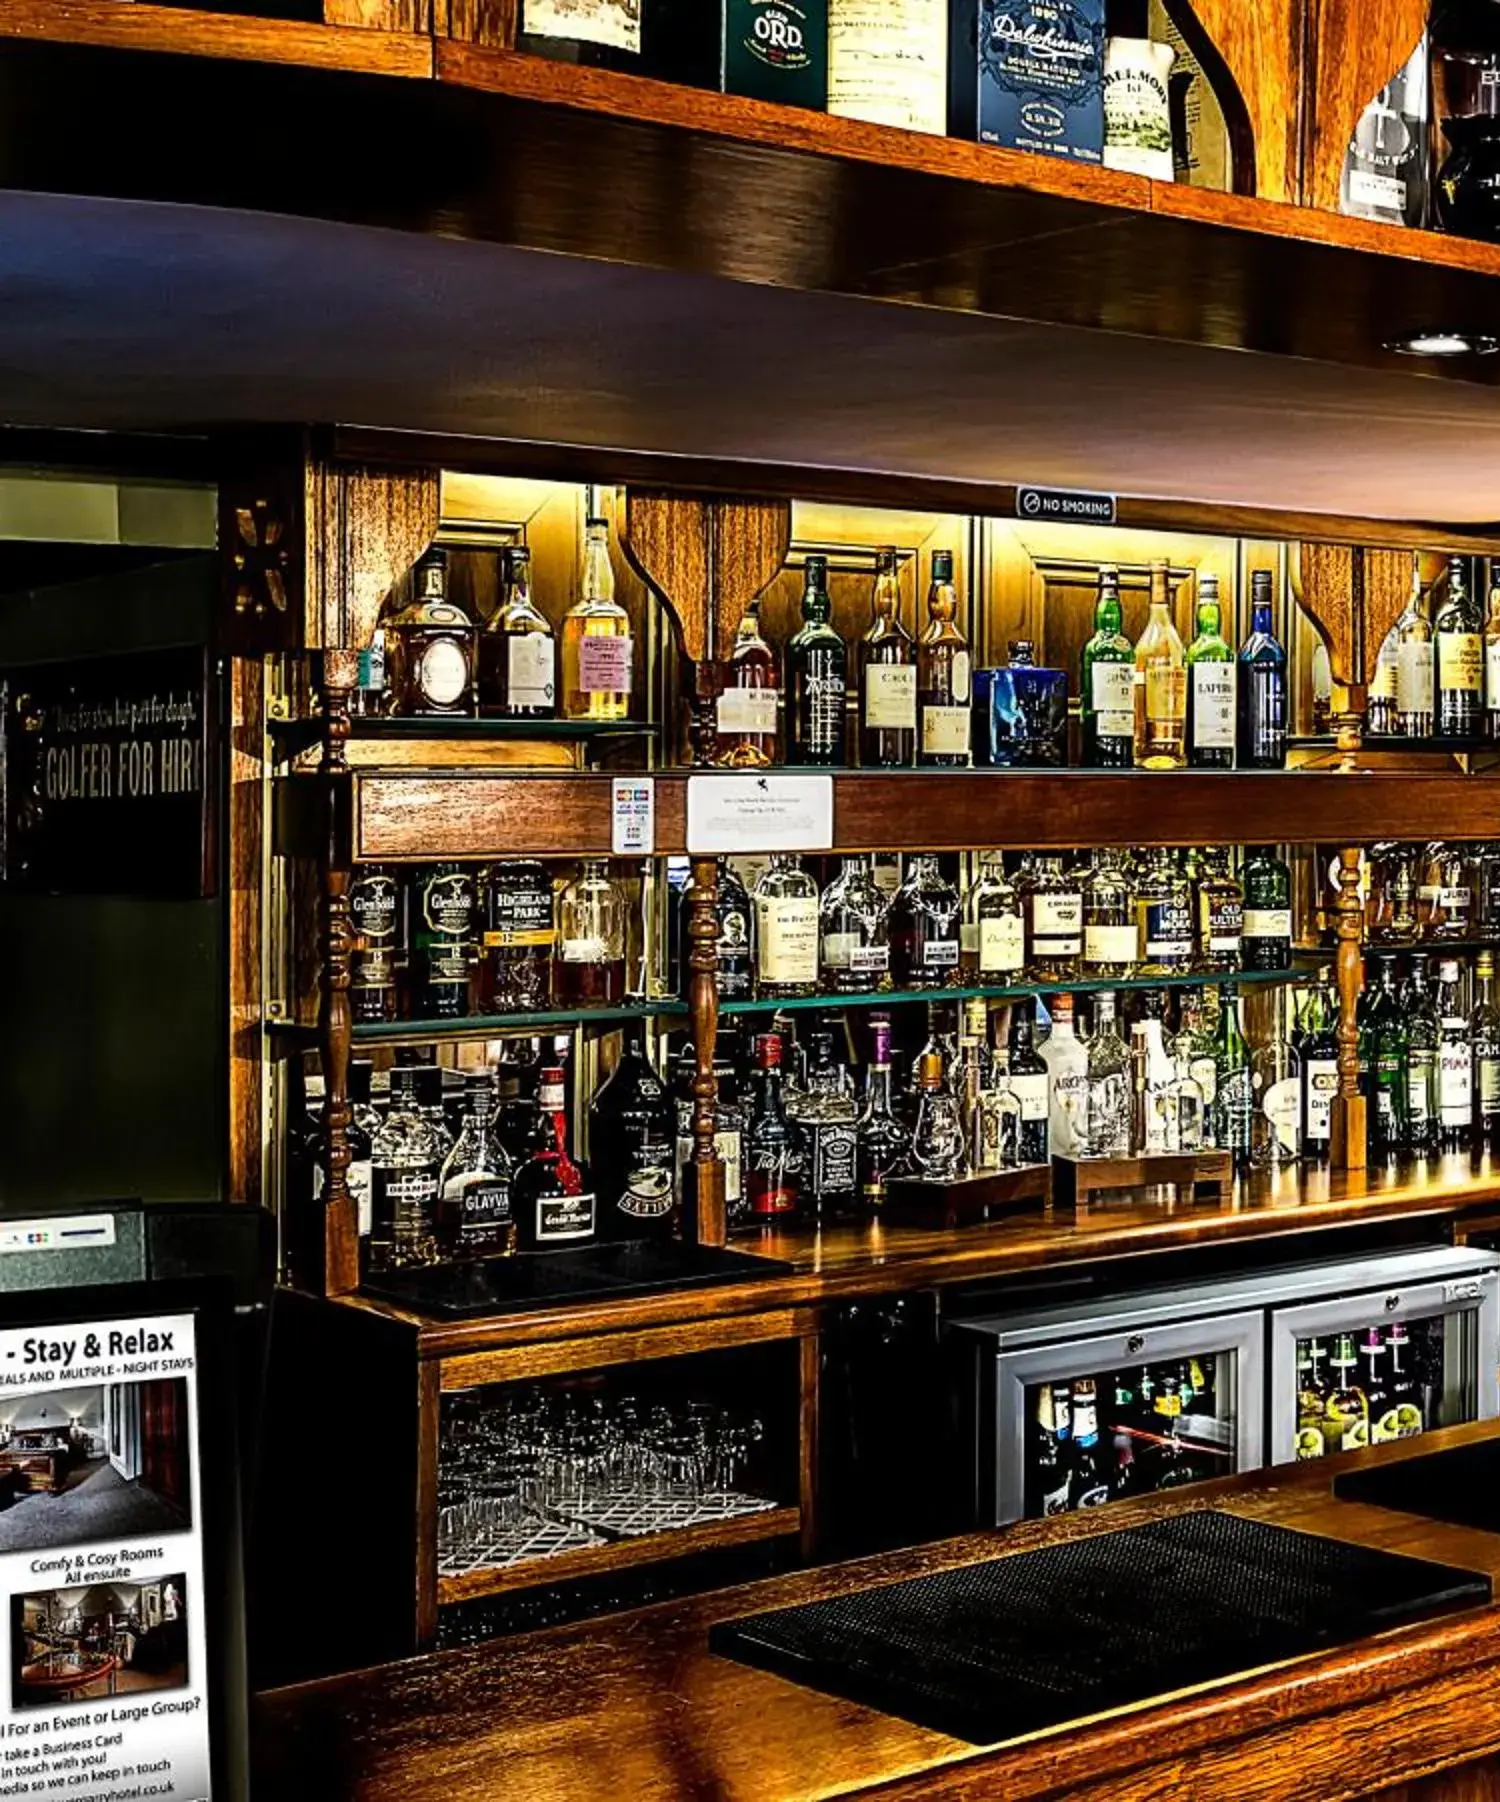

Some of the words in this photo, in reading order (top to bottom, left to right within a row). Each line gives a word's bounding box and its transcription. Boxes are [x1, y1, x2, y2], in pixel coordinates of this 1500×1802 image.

[754, 15, 803, 49] ORD
[991, 13, 1095, 63] Dalwhinnie
[1042, 498, 1060, 511] NO
[1061, 499, 1111, 515] SMOKING
[46, 744, 112, 800] GOLFER
[117, 740, 154, 797] FOR
[513, 907, 541, 919] PARK
[465, 1191, 510, 1211] GLAYVA
[23, 1338, 77, 1367] Stay
[83, 1332, 101, 1359] &
[108, 1327, 174, 1356] Relax
[0, 1372, 27, 1386] EALS
[28, 1370, 56, 1383] AND
[59, 1363, 115, 1382] MULTIPLE
[123, 1358, 159, 1375] NIGHT
[161, 1357, 195, 1371] STAYS
[30, 1555, 73, 1573] Comfy
[75, 1554, 85, 1568] &
[87, 1552, 118, 1566] Cosy
[120, 1547, 164, 1562] Rooms
[64, 1571, 82, 1585] All
[83, 1566, 132, 1582] ensuite
[8, 1722, 30, 1738] For
[33, 1719, 50, 1733] an
[53, 1714, 91, 1731] Event
[93, 1711, 109, 1725] or
[111, 1705, 149, 1725] Large
[151, 1695, 201, 1717] Group?
[5, 1746, 30, 1761] take
[32, 1747, 40, 1757] a
[43, 1738, 93, 1755] Business
[95, 1732, 123, 1748] Card
[15, 1760, 50, 1777] touch
[52, 1756, 79, 1771] with
[81, 1751, 107, 1769] you!
[31, 1780, 45, 1791] so
[47, 1776, 65, 1789] we
[67, 1773, 89, 1786] can
[91, 1767, 120, 1783] keep
[122, 1764, 134, 1776] in
[136, 1758, 171, 1774] touch
